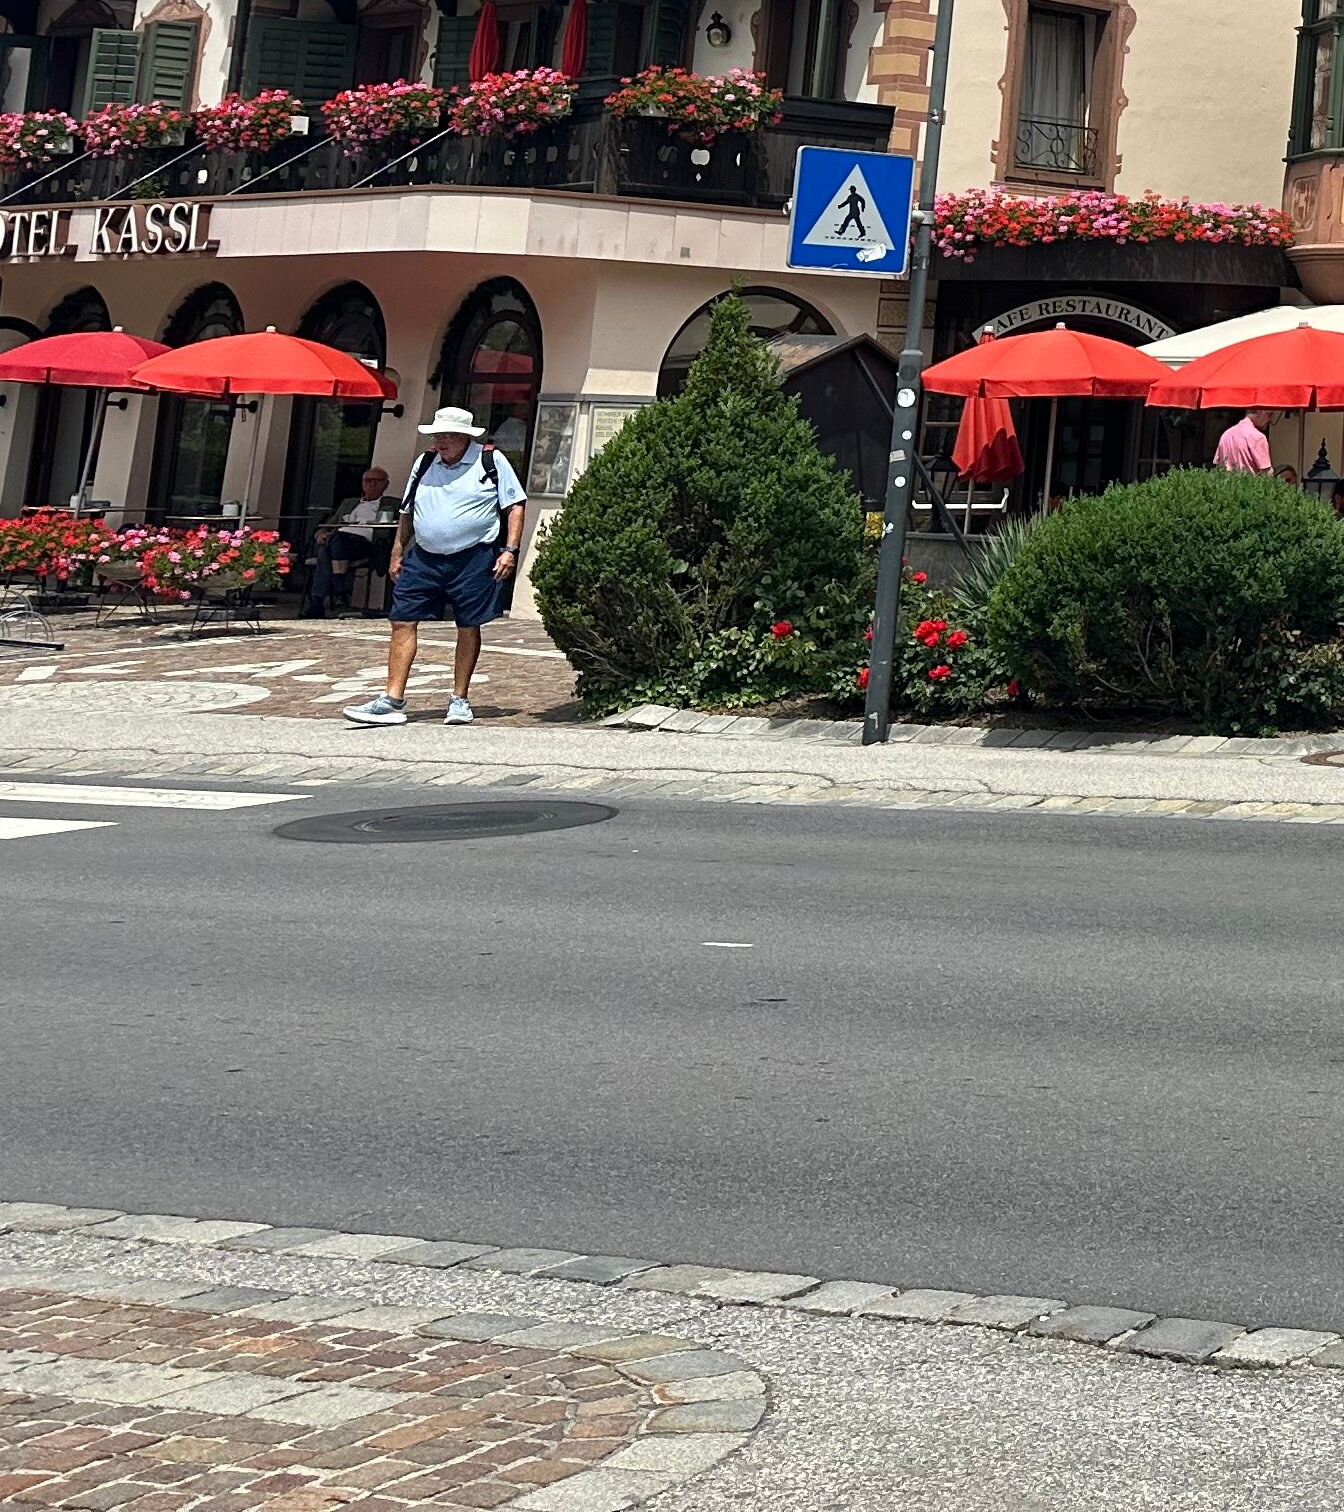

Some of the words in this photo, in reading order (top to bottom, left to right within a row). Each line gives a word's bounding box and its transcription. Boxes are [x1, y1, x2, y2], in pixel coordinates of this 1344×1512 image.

[91, 201, 209, 254] KASSL
[995, 307, 1033, 334] AFE
[1038, 298, 1169, 340] RESTAURANT
